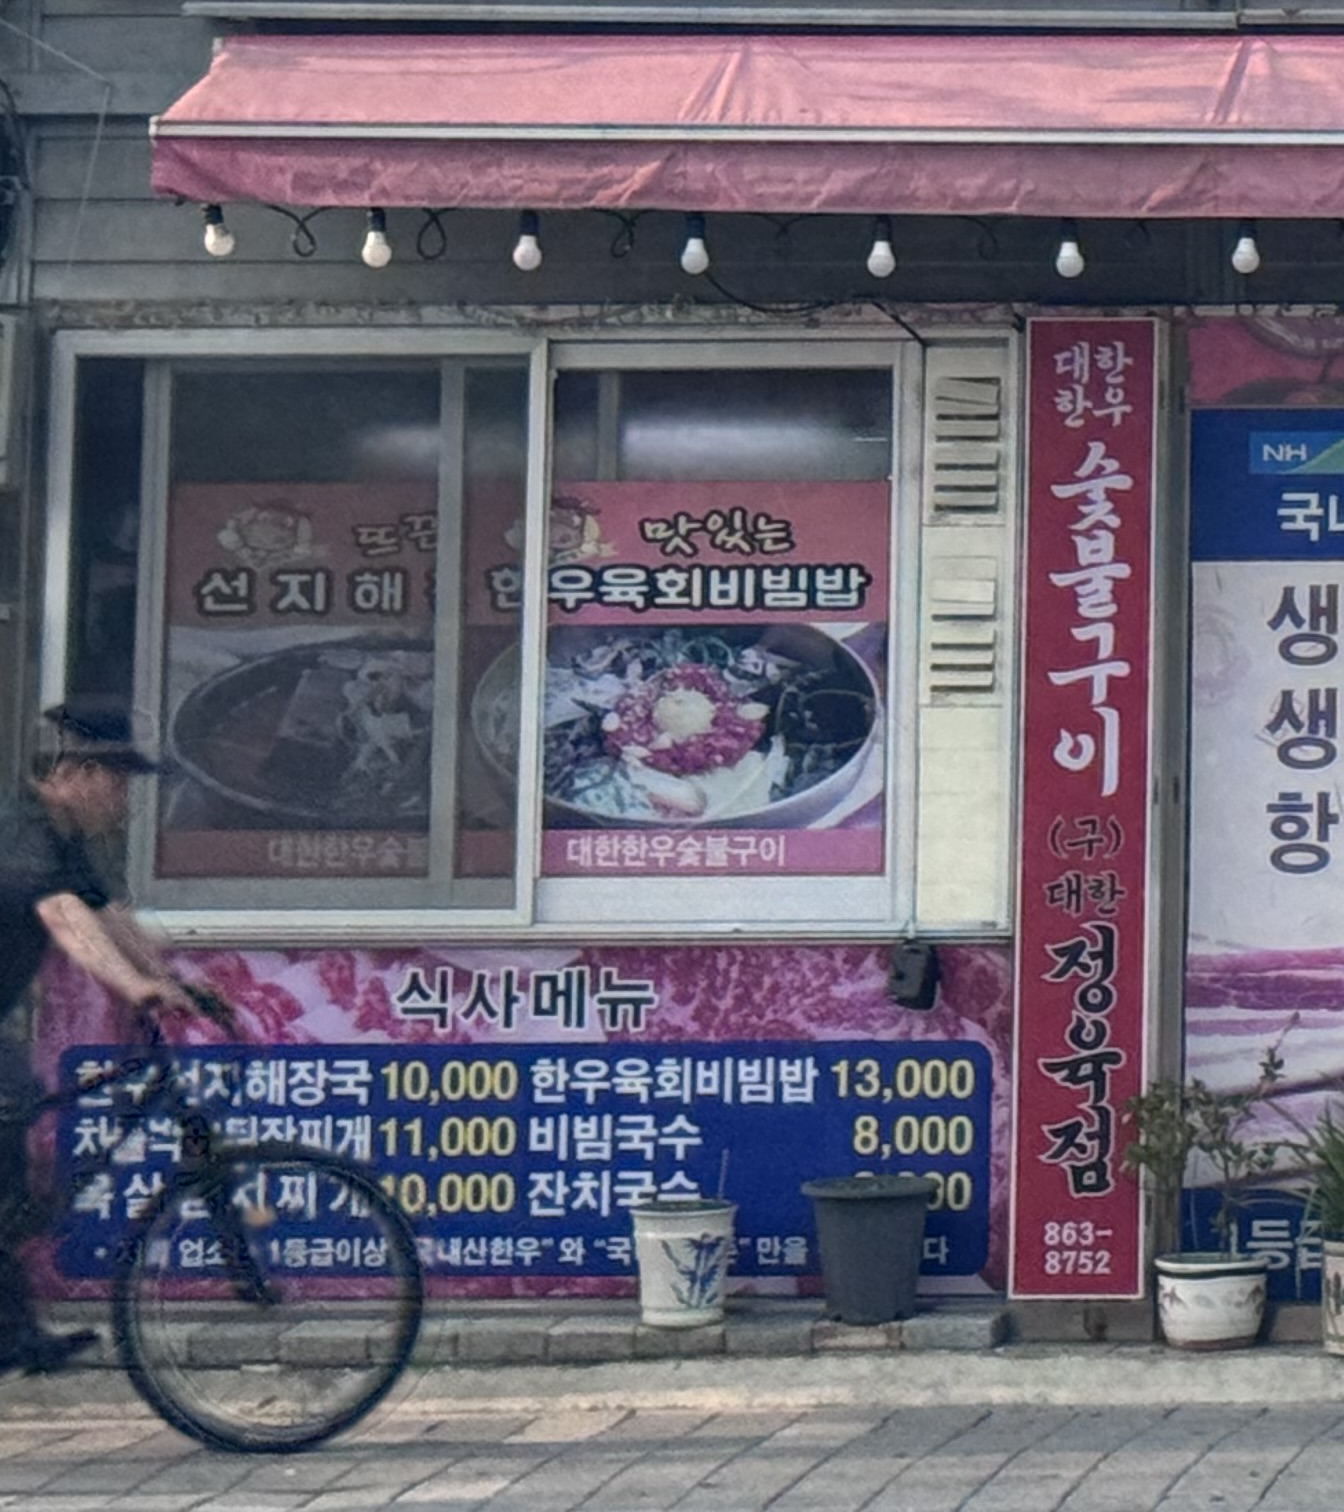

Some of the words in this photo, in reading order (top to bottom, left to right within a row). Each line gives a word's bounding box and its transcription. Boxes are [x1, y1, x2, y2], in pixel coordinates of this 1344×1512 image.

[1053, 341, 1134, 385] 대한
[1053, 384, 1134, 429] 한우
[1261, 443, 1308, 463] NH
[640, 507, 795, 555] 맛있는
[199, 567, 438, 613] 선지해
[1048, 440, 1134, 798] 숯불구이
[566, 834, 786, 868] 대한한우숯불구이
[1047, 815, 1123, 859] (구)
[1045, 870, 1125, 917] 대한
[396, 967, 656, 1032] 식사메뉴
[380, 1060, 519, 1103] 10,000
[530, 1057, 820, 1104] 한우육회비빔밥
[831, 1058, 975, 1103] 13,000
[1040, 920, 1126, 1198] 정육점
[378, 1116, 517, 1162] 11,000
[528, 1113, 703, 1161] 비빔국수
[852, 1115, 975, 1160] 8,000
[269, 1238, 388, 1268] 1등급이상
[558, 1237, 587, 1267] 와
[756, 1236, 808, 1266] 만을
[1043, 1221, 1113, 1246] 863-
[1044, 1251, 1111, 1274] 8752
